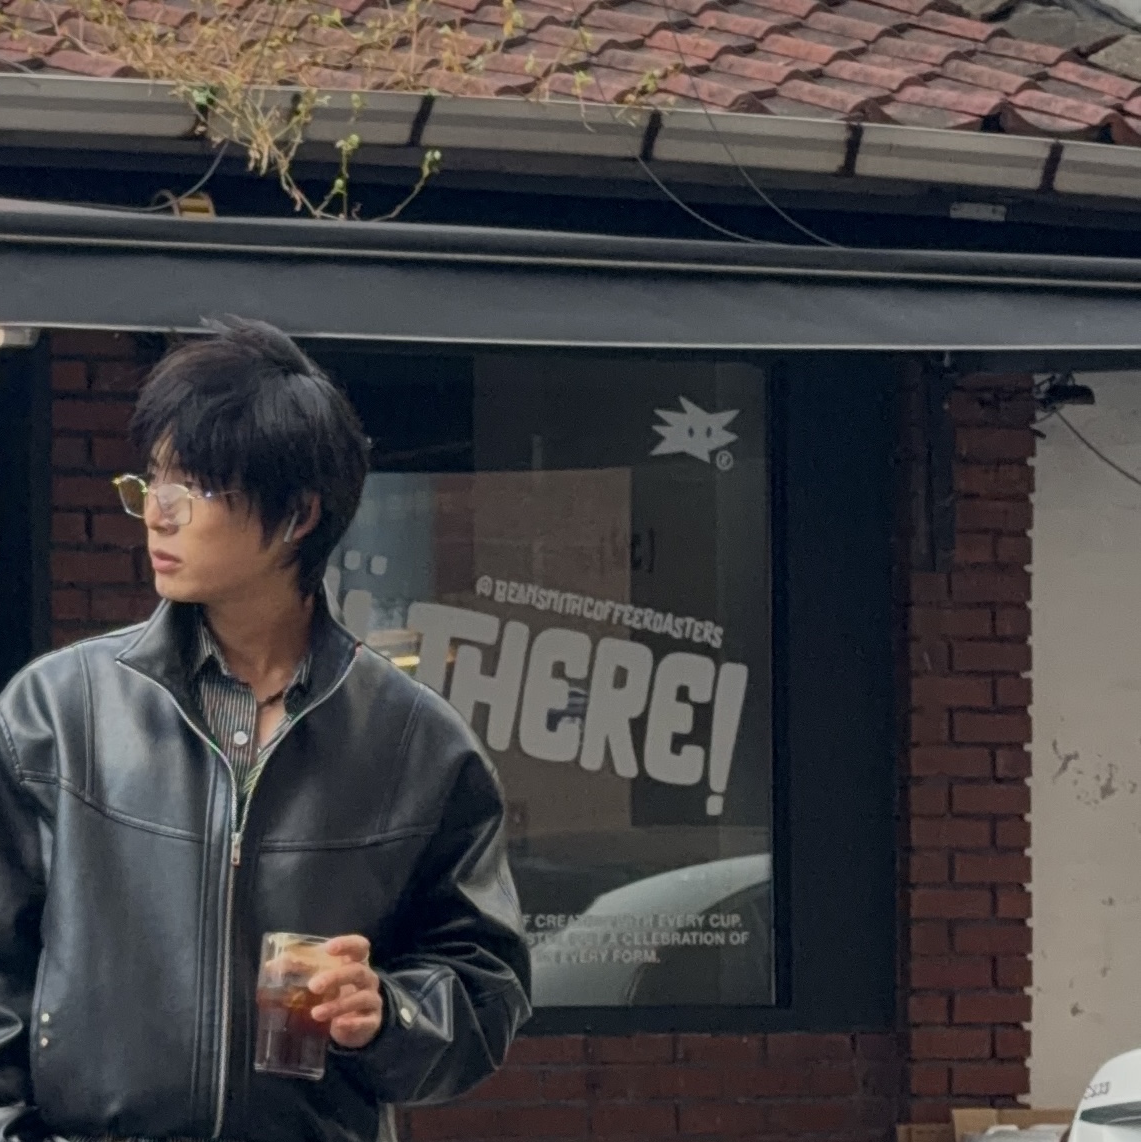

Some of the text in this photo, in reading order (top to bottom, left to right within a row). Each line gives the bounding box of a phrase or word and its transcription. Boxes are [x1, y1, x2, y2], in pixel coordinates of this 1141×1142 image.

[407, 601, 749, 816] THERE!
[657, 914, 706, 929] EVERY
[709, 914, 743, 929] CUP.
[622, 931, 726, 946] CELEBRATION
[729, 931, 750, 945] OF
